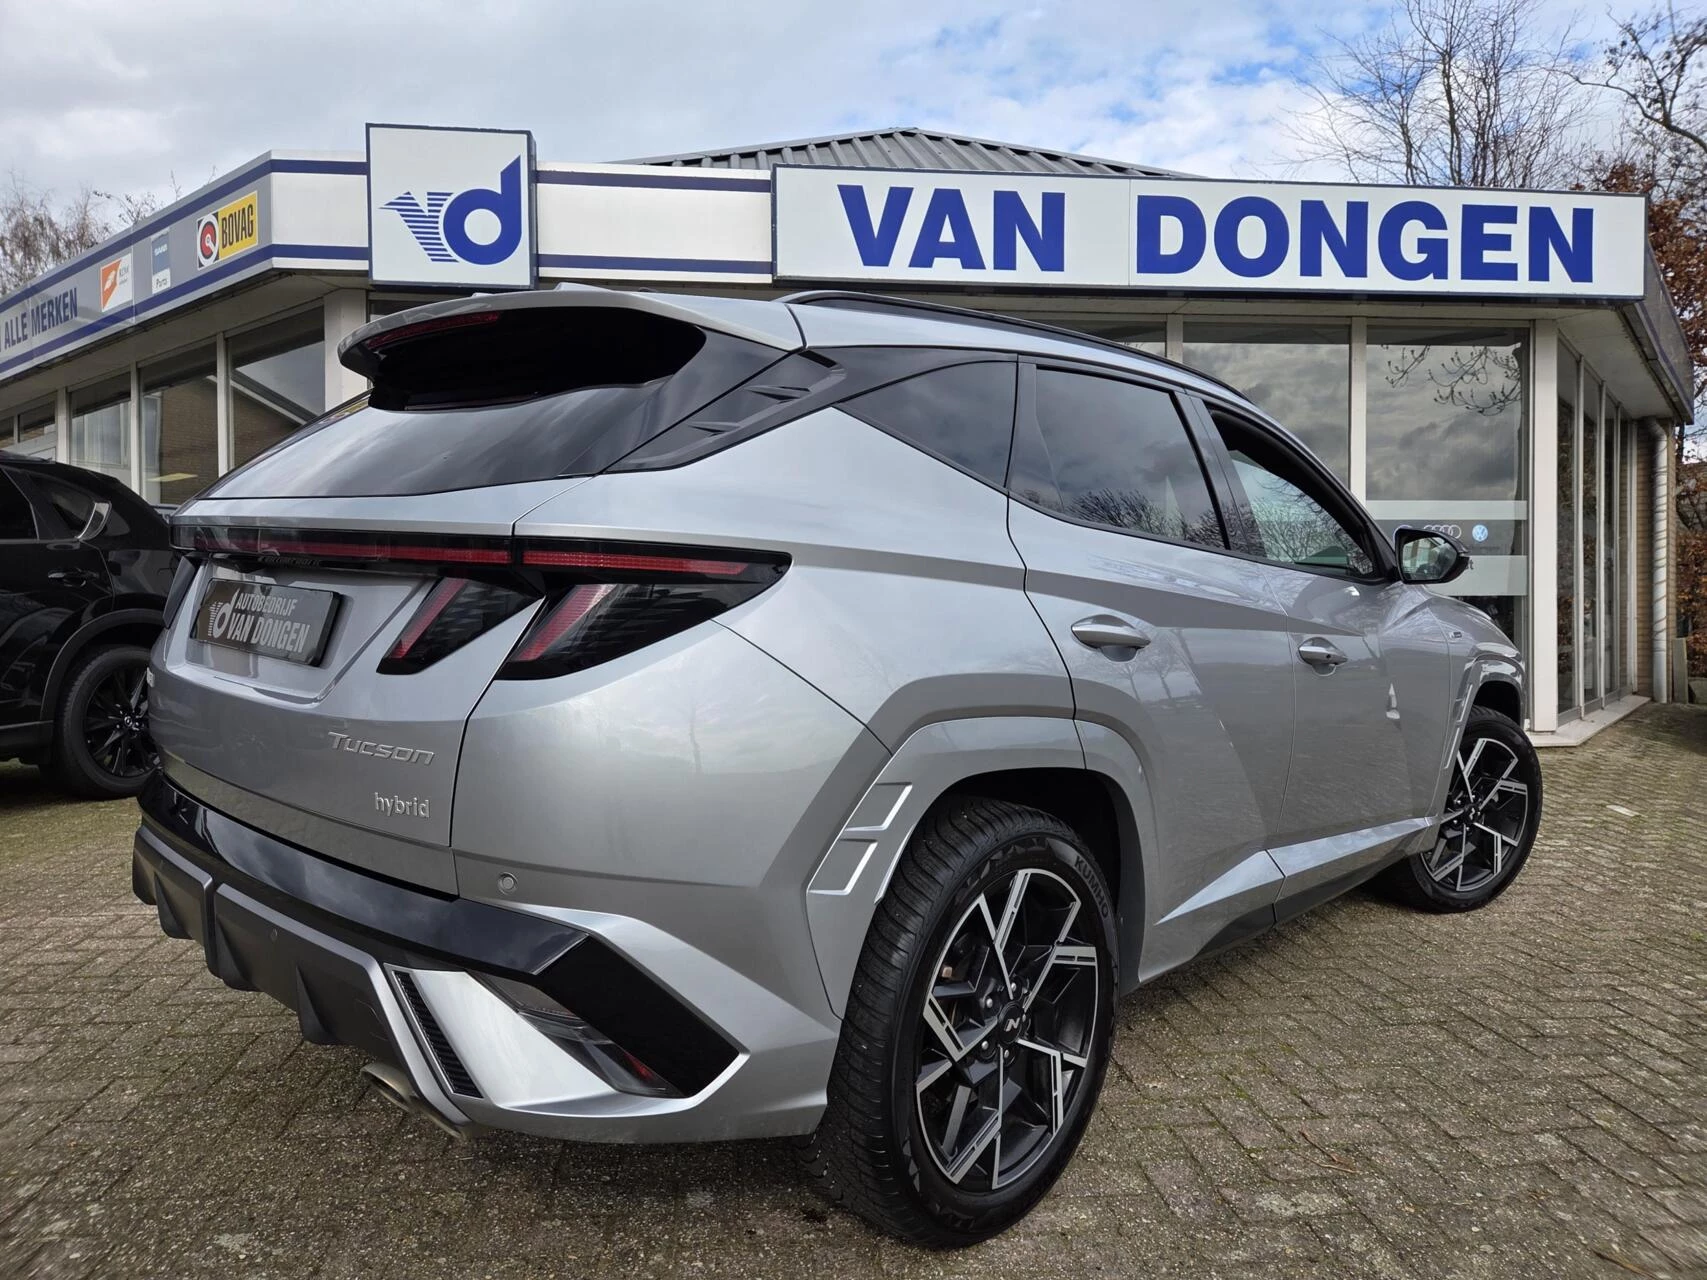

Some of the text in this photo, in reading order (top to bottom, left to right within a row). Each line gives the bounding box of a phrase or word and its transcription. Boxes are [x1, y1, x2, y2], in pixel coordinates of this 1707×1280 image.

[222, 204, 254, 249] BOVAG
[837, 184, 1594, 283] VAN DONGEN
[5, 287, 78, 350] ALLE MERKEN
[235, 592, 298, 617] AUTOBEDRIJF
[226, 612, 310, 653] VAN DONGEN
[374, 791, 430, 818] hybrid
[1074, 855, 1109, 918] KUMHO
